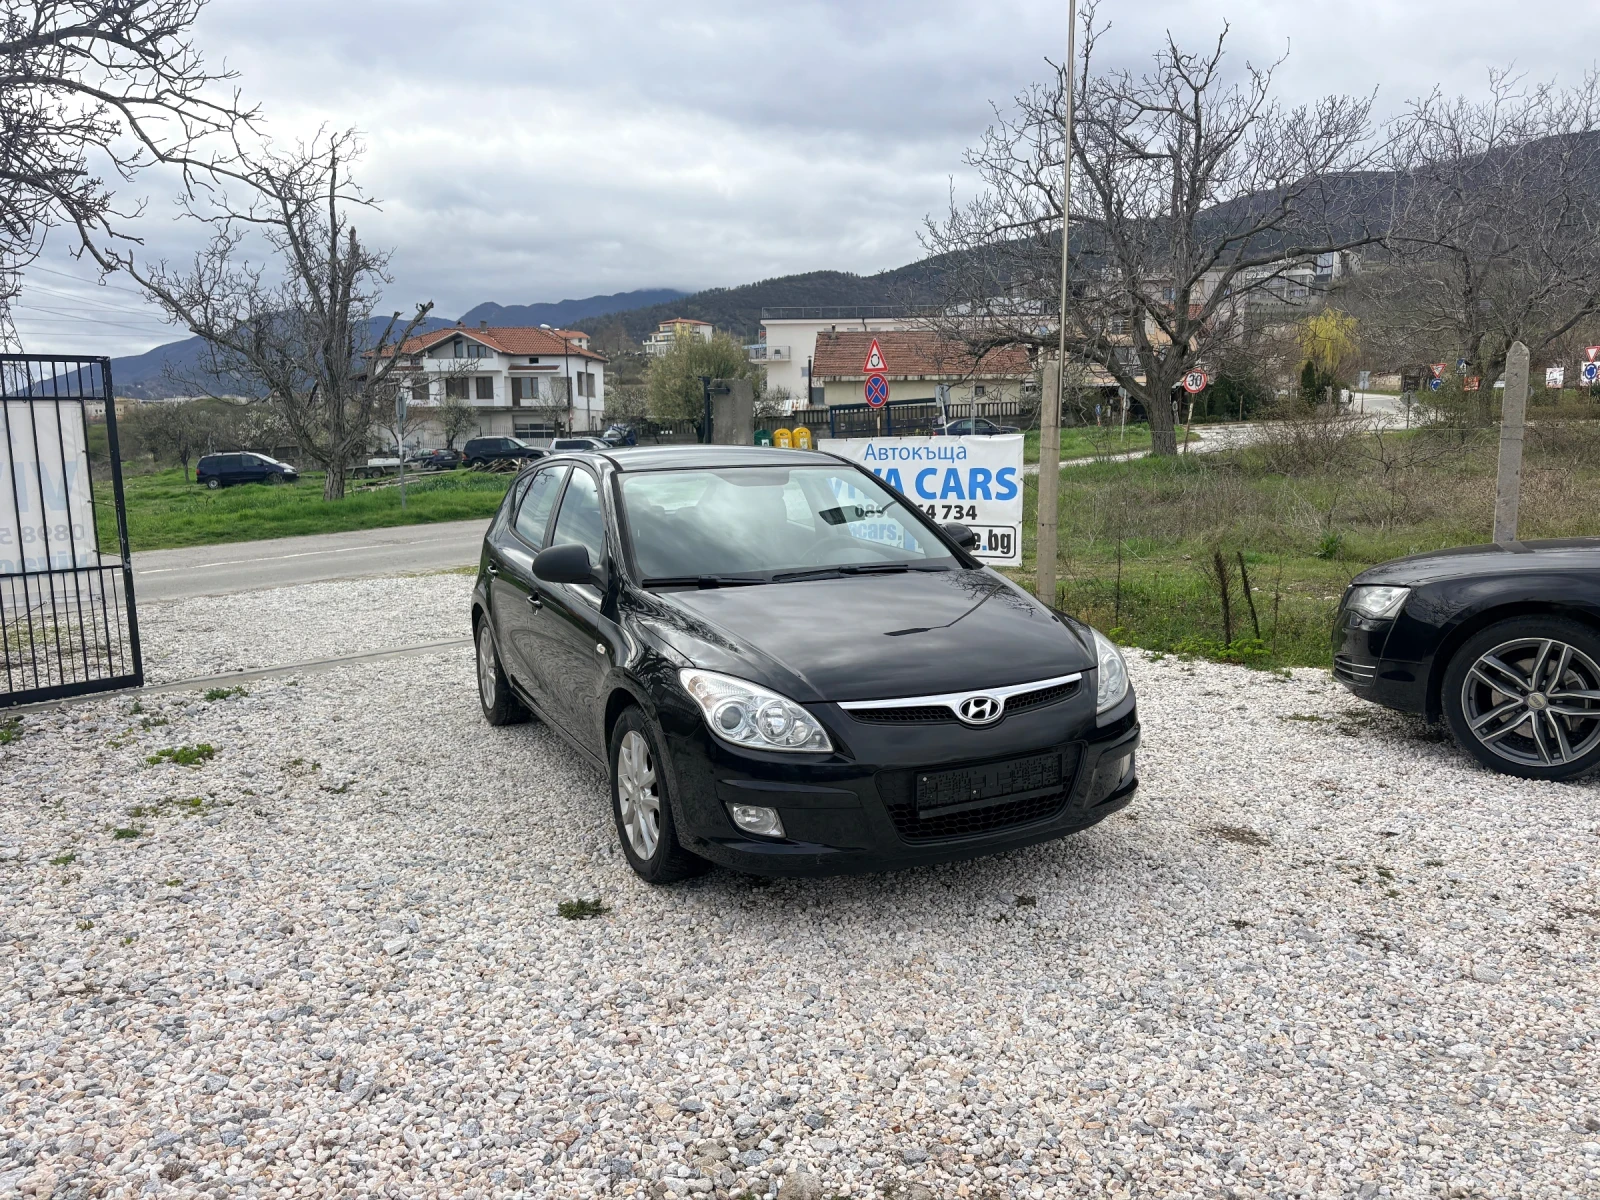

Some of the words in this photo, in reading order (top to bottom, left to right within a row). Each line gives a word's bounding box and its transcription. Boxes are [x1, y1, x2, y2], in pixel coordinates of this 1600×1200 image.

[1188, 374, 1203, 387] 30
[864, 443, 967, 463] Автокъща
[915, 467, 1018, 501] CARS
[942, 505, 977, 520] 734
